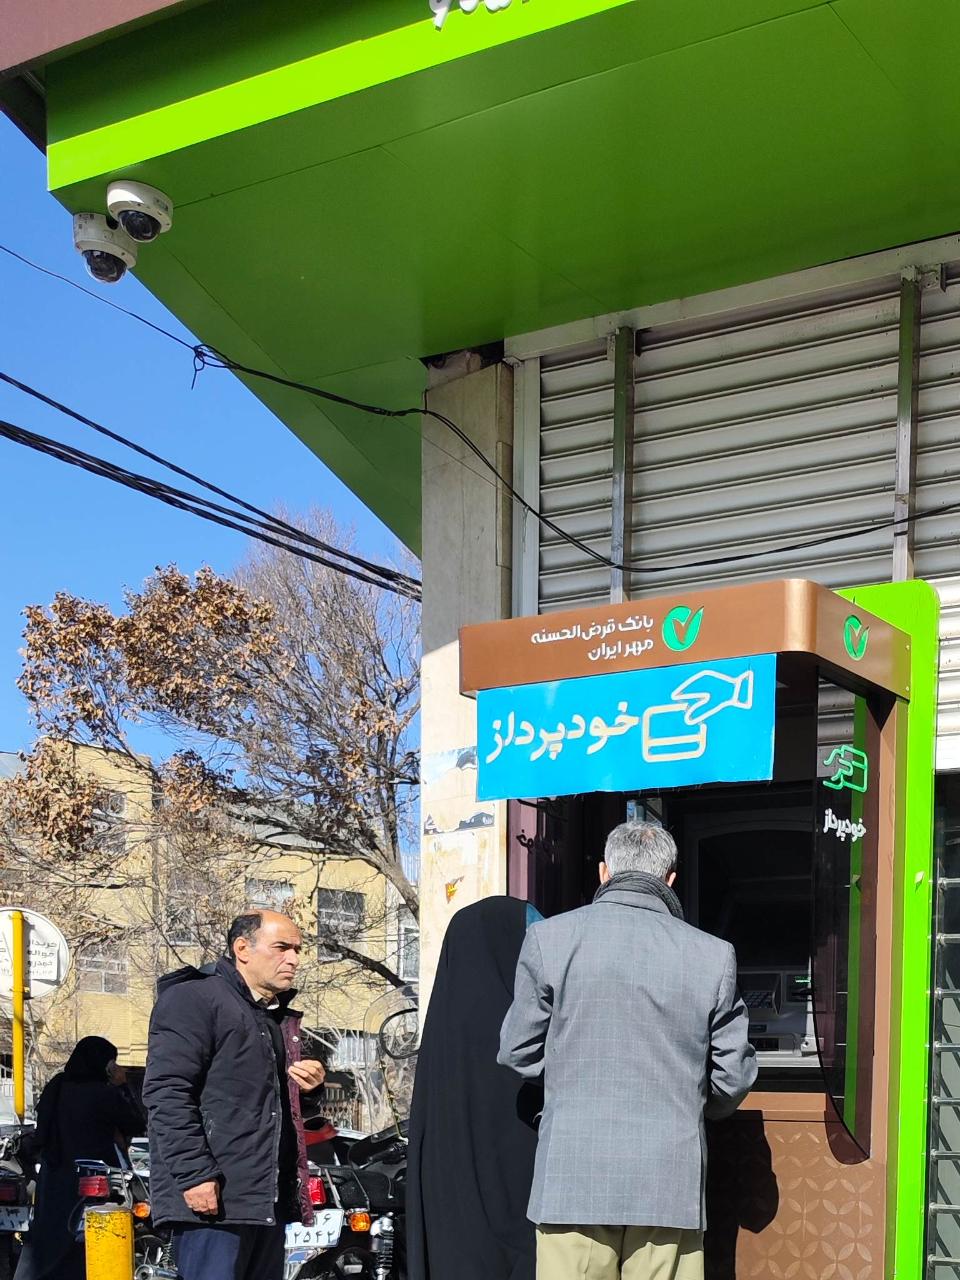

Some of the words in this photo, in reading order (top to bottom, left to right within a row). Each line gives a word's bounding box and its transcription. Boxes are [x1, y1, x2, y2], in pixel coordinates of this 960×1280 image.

[618, 615, 654, 633] بانک
[587, 640, 622, 661] ایران
[623, 638, 654, 657] مهر
[485, 701, 640, 764] خودپرداز
[822, 808, 867, 843] خودپرداز
